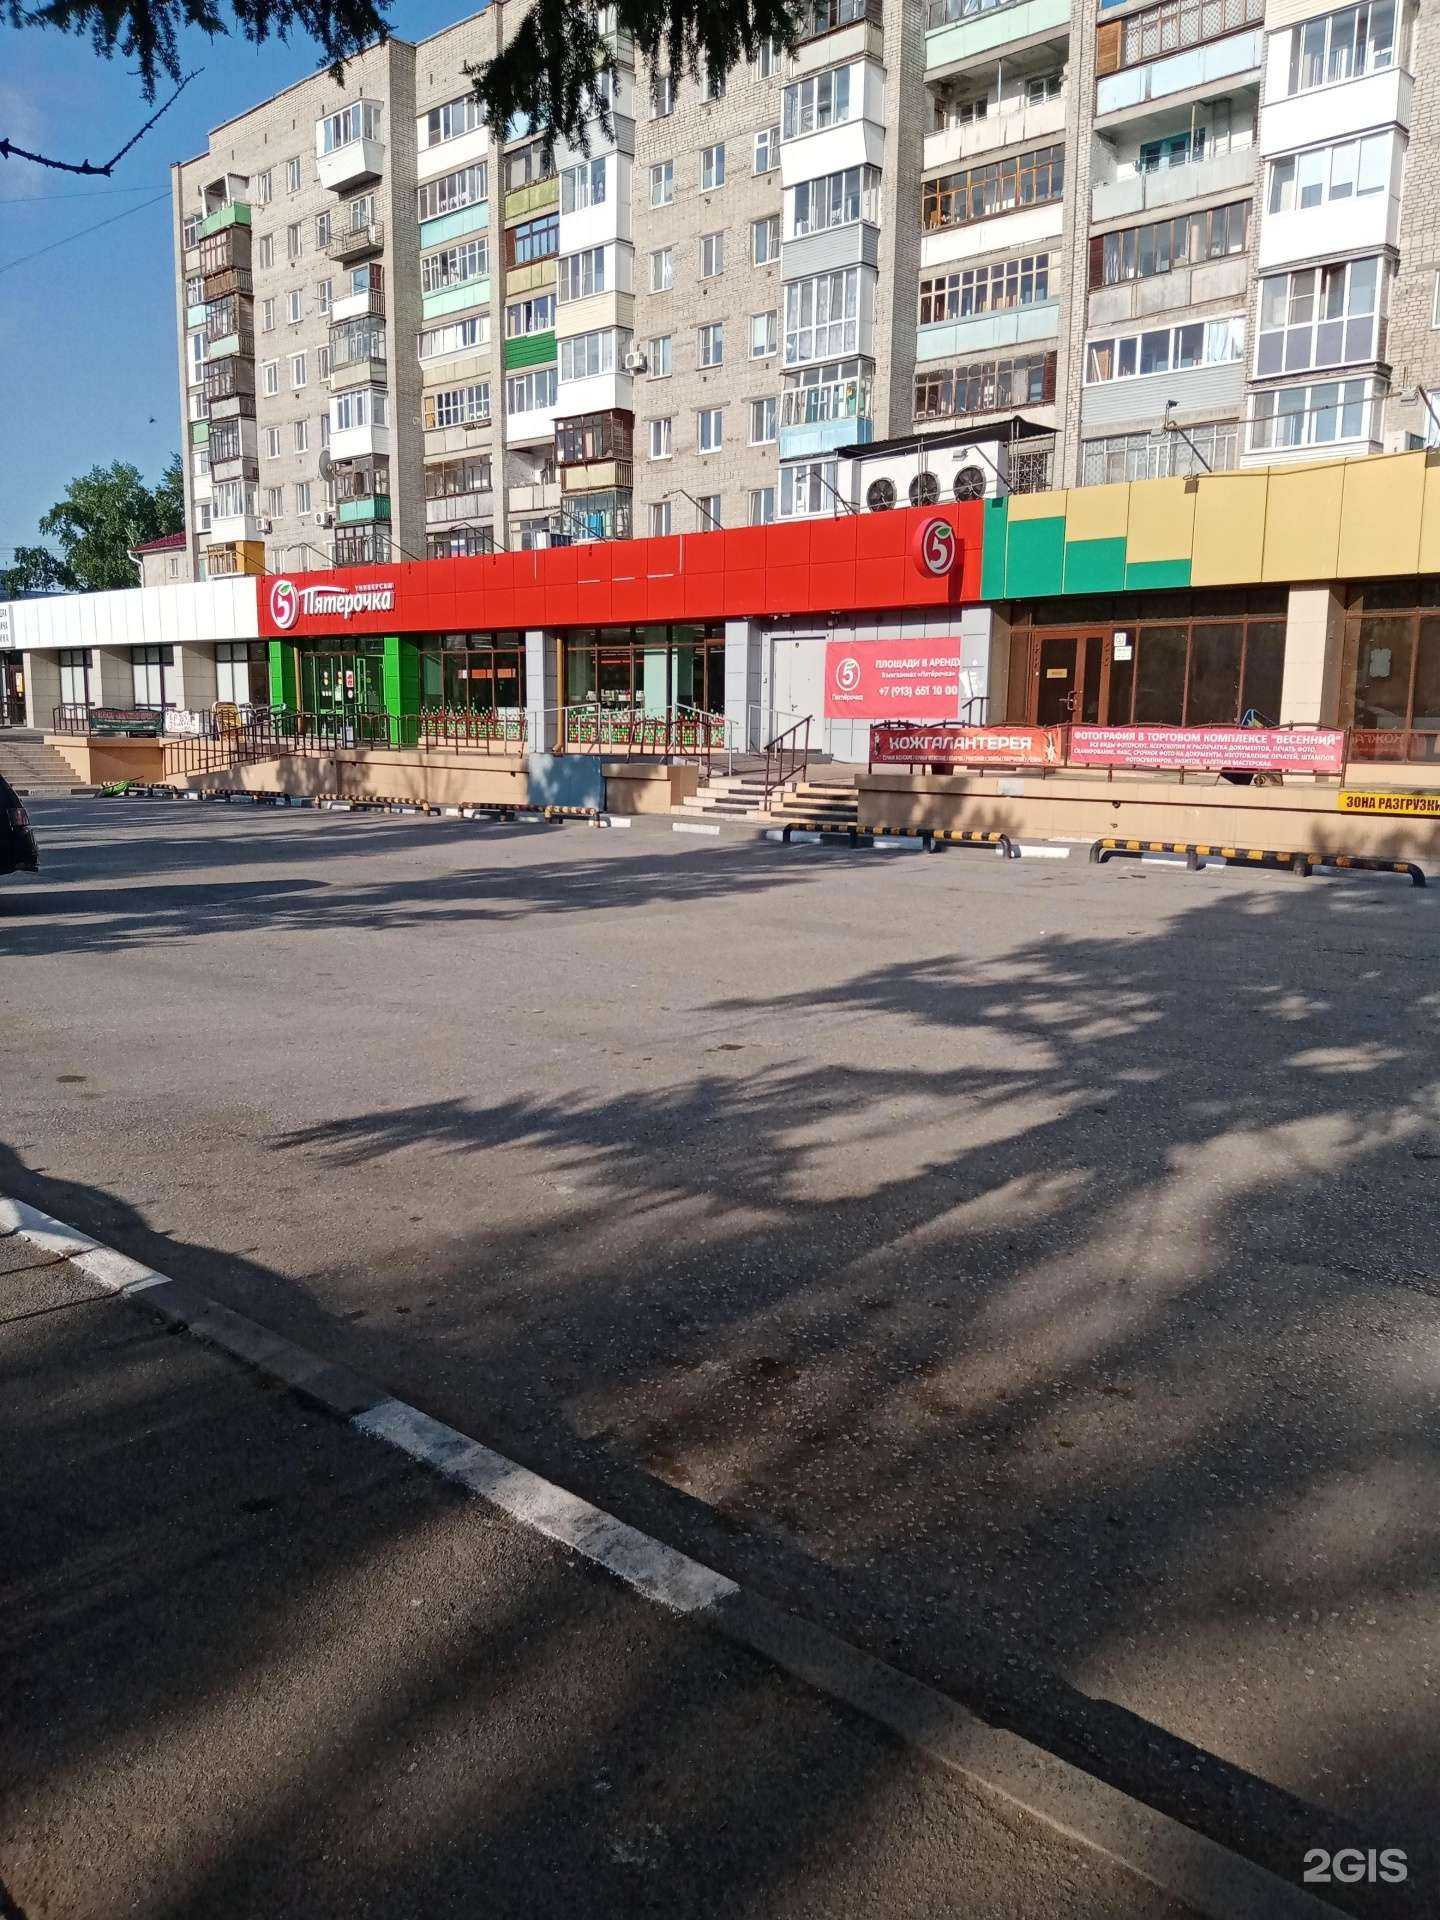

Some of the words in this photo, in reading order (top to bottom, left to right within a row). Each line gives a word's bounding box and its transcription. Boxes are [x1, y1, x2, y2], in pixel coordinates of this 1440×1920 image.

[875, 659, 920, 669] ПЛОЩАДИ
[922, 658, 929, 668] В
[879, 686, 890, 697] +7
[891, 686, 913, 698] (913)
[915, 686, 930, 696] 651
[932, 686, 943, 696] 10
[945, 685, 958, 696] 00
[889, 735, 1033, 751] КОЖГАЛАНТЕРЕЯ
[1074, 731, 1136, 741] ФОТОГРАФИЯ
[1138, 732, 1145, 741] В
[1148, 733, 1201, 742] ТОРГОВОМ
[1204, 734, 1268, 743] КОМПЛЕКСЕ
[1346, 796, 1376, 809] ЗОНА
